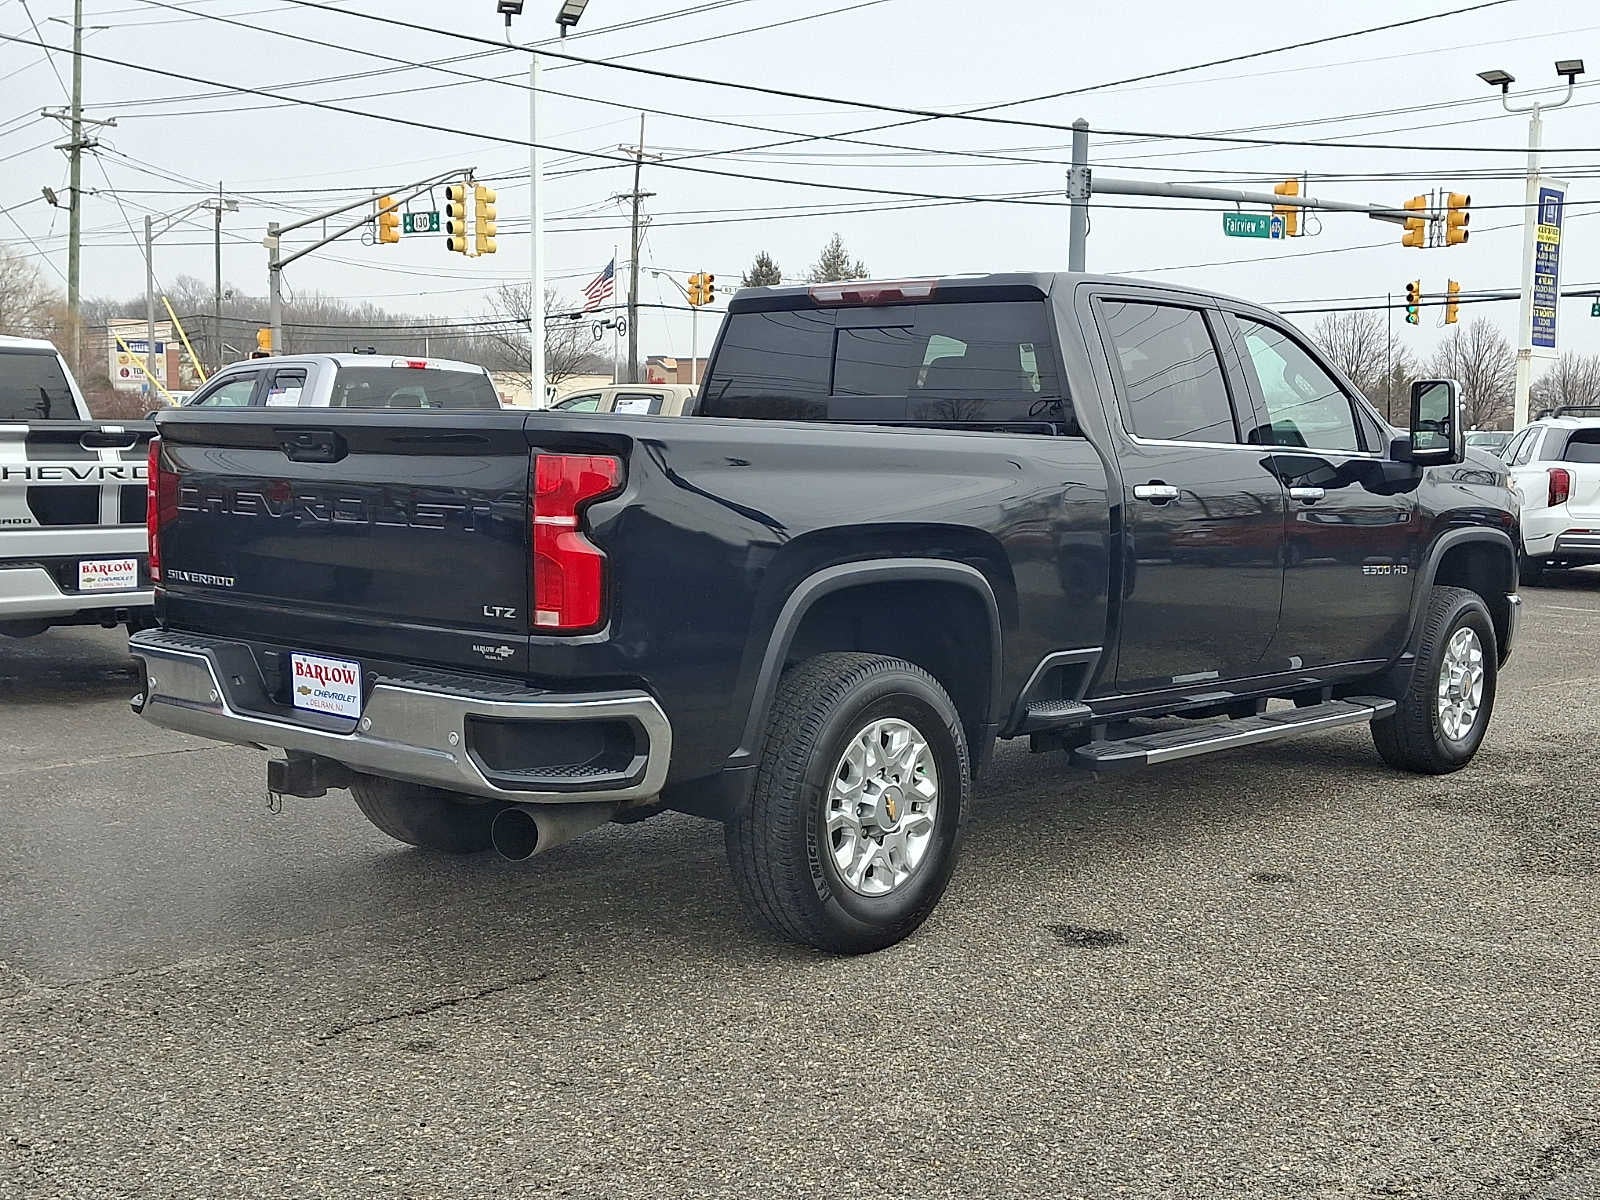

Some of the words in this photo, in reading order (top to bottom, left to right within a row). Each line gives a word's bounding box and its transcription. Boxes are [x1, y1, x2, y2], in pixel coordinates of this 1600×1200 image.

[415, 216, 428, 228] 130
[1226, 217, 1257, 233] Fairview
[177, 486, 491, 532] CHEVROLET
[82, 563, 134, 576] BARLOW
[1362, 565, 1391, 575] 2500
[1393, 565, 1408, 576] HD
[167, 569, 235, 587] SILVERADO
[483, 605, 517, 619] LTZ
[295, 661, 356, 687] BARLOW
[313, 689, 357, 703] CHEVROLET
